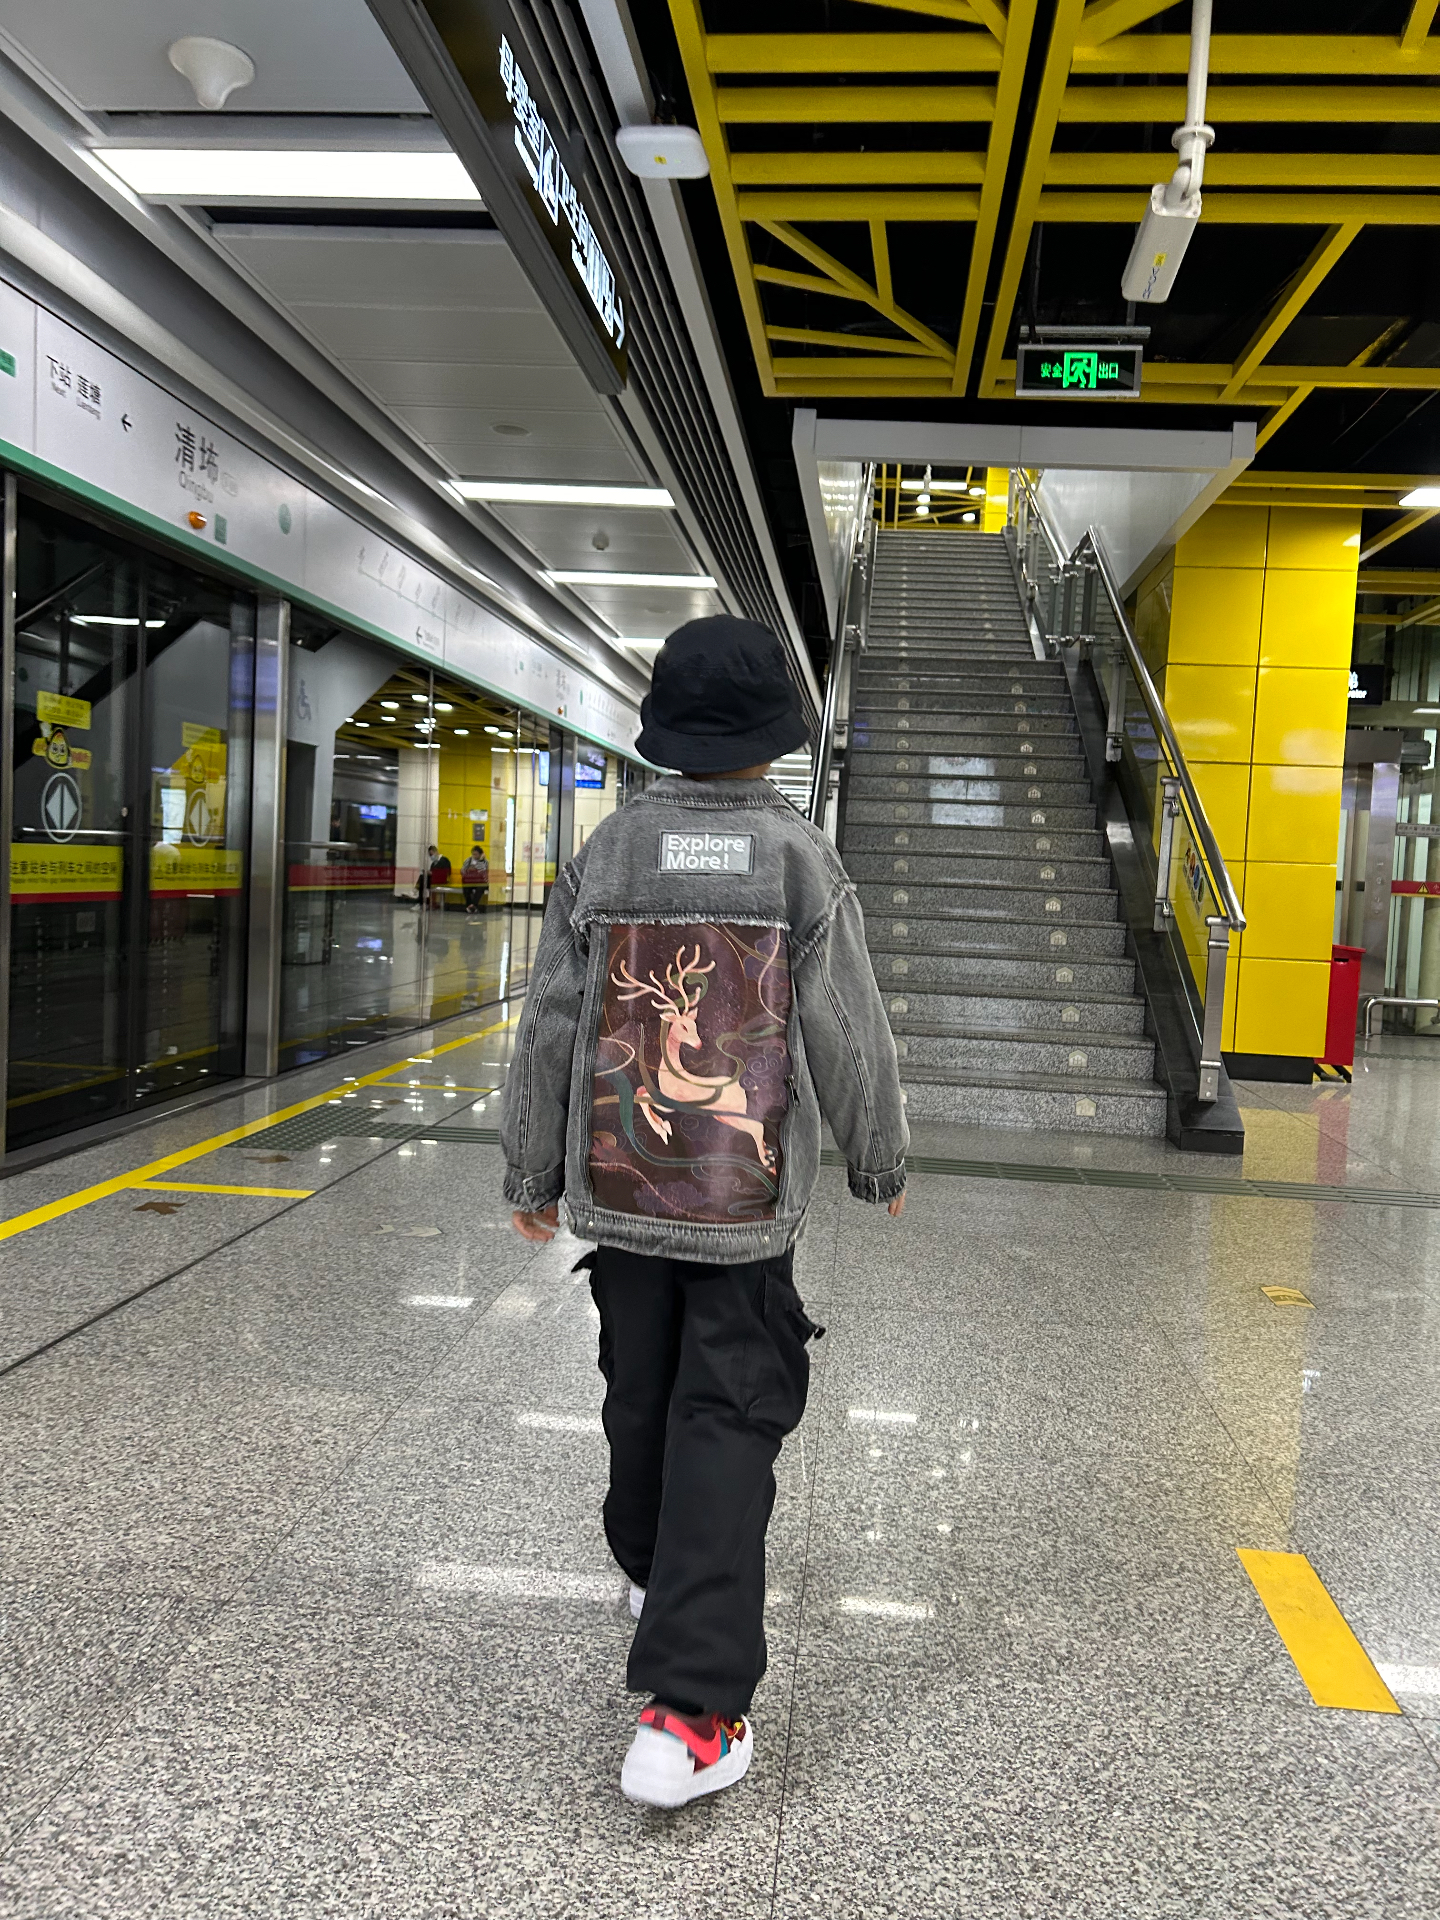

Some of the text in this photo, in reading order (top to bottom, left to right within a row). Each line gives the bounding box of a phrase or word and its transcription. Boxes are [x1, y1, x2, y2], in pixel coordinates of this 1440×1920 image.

[1041, 361, 1119, 379] 安全 出口
[667, 833, 746, 855] Explore
[666, 850, 729, 870] More!
